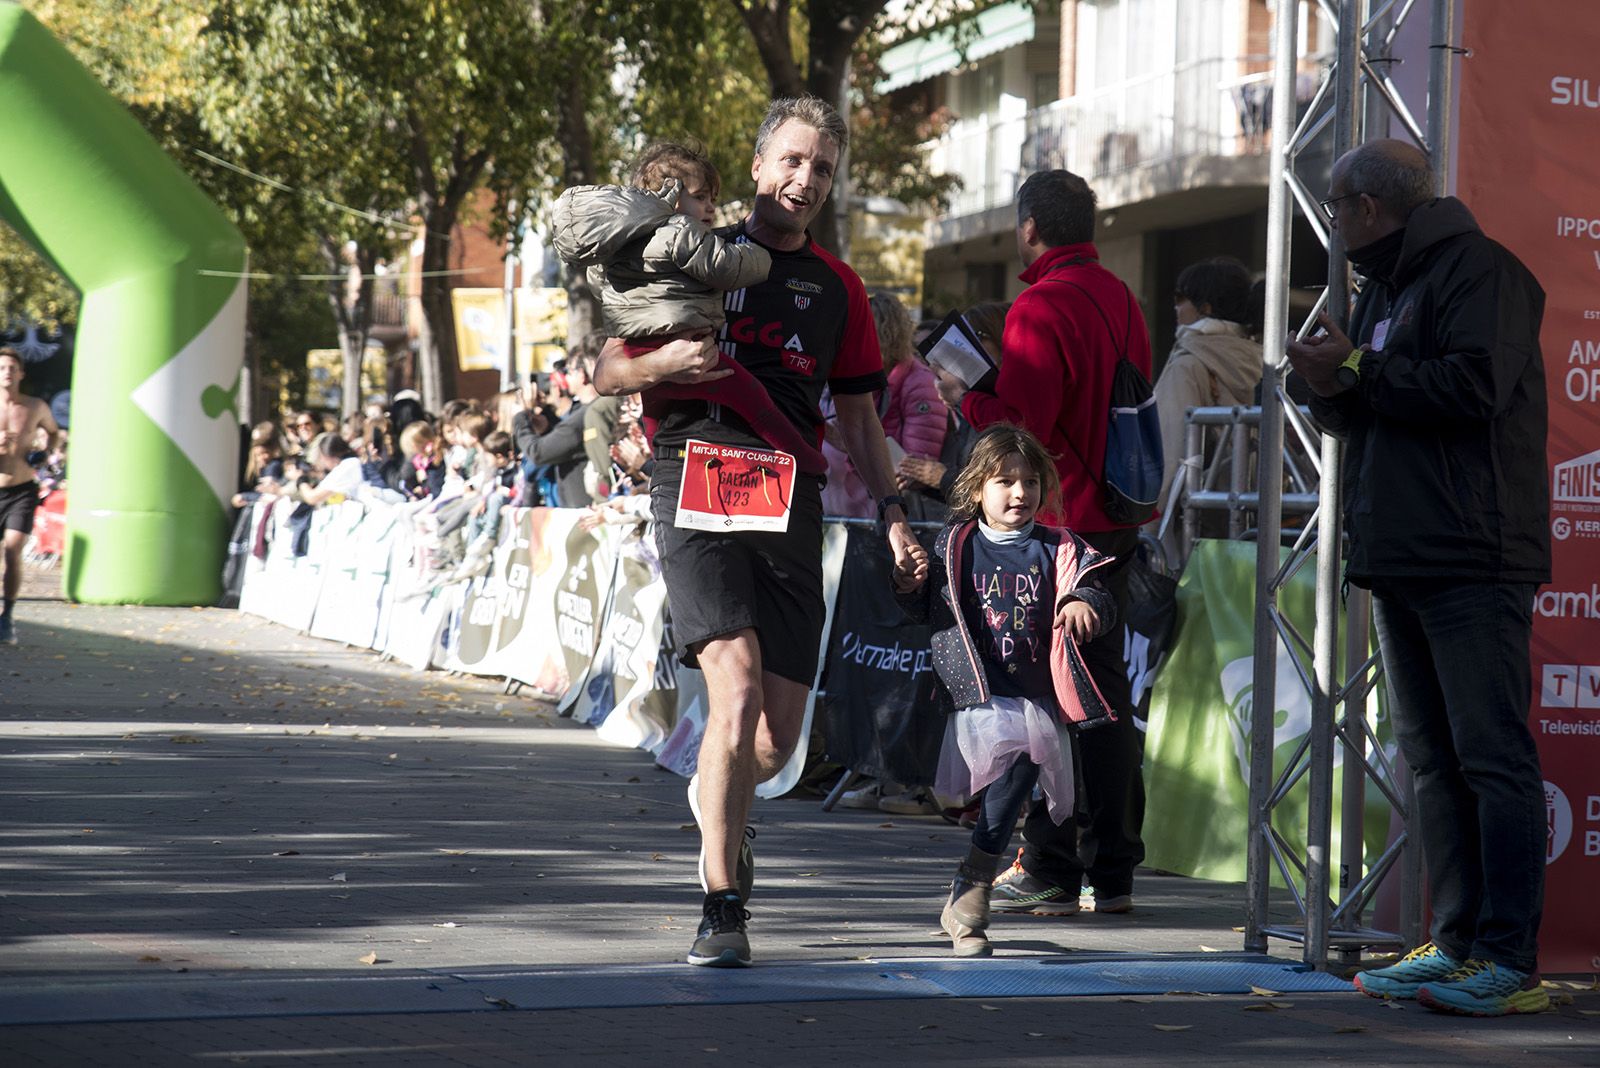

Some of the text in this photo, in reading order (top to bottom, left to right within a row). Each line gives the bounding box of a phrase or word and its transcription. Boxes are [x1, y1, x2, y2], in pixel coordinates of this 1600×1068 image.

[1551, 76, 1600, 108] SIL
[790, 355, 811, 371] TRI
[692, 445, 719, 456] MITJA
[721, 448, 746, 459] SANT
[724, 490, 750, 507] 423
[973, 573, 1041, 601] HAPPY
[1532, 583, 1600, 619] amb
[1013, 606, 1036, 631] BE
